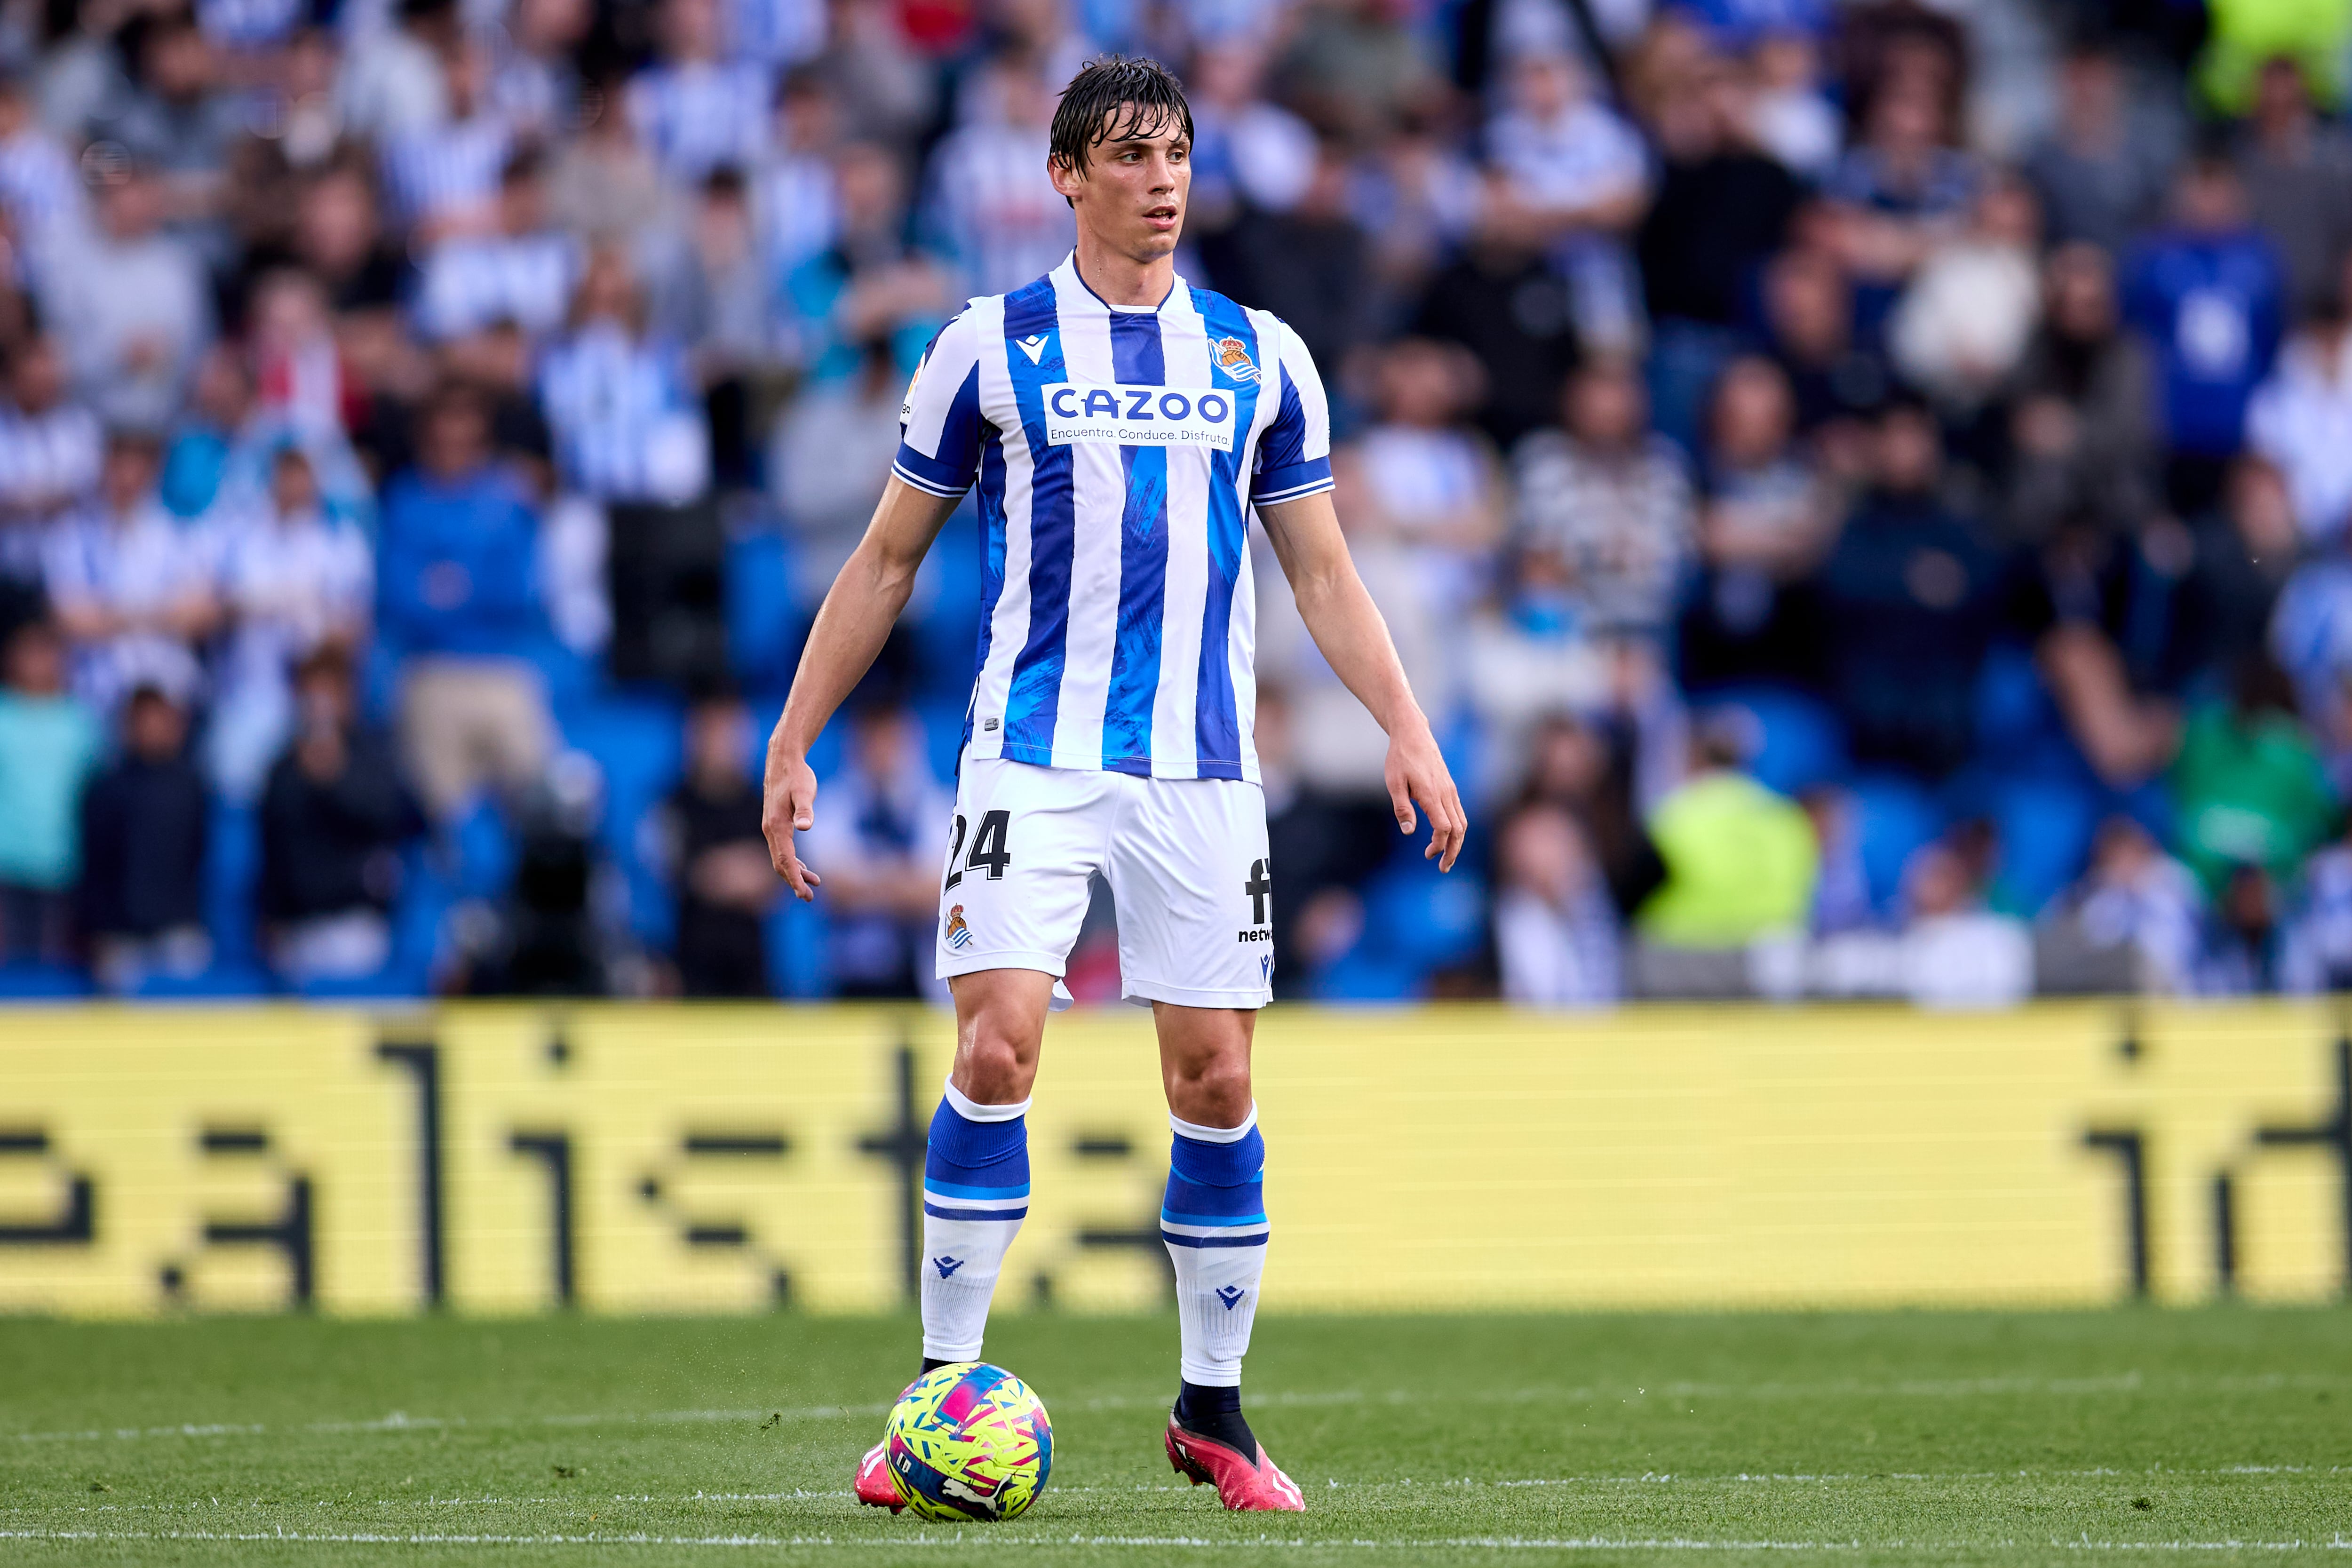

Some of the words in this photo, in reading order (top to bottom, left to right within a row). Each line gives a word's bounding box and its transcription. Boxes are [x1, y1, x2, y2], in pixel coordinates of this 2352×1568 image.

[1051, 389, 1228, 423] CAZOO
[1051, 428, 1116, 439] Encuentra.
[1119, 429, 1177, 439] Conduce.
[1181, 430, 1230, 446] Disfruta.
[944, 810, 1011, 896] 24
[1239, 927, 1272, 942] netw
